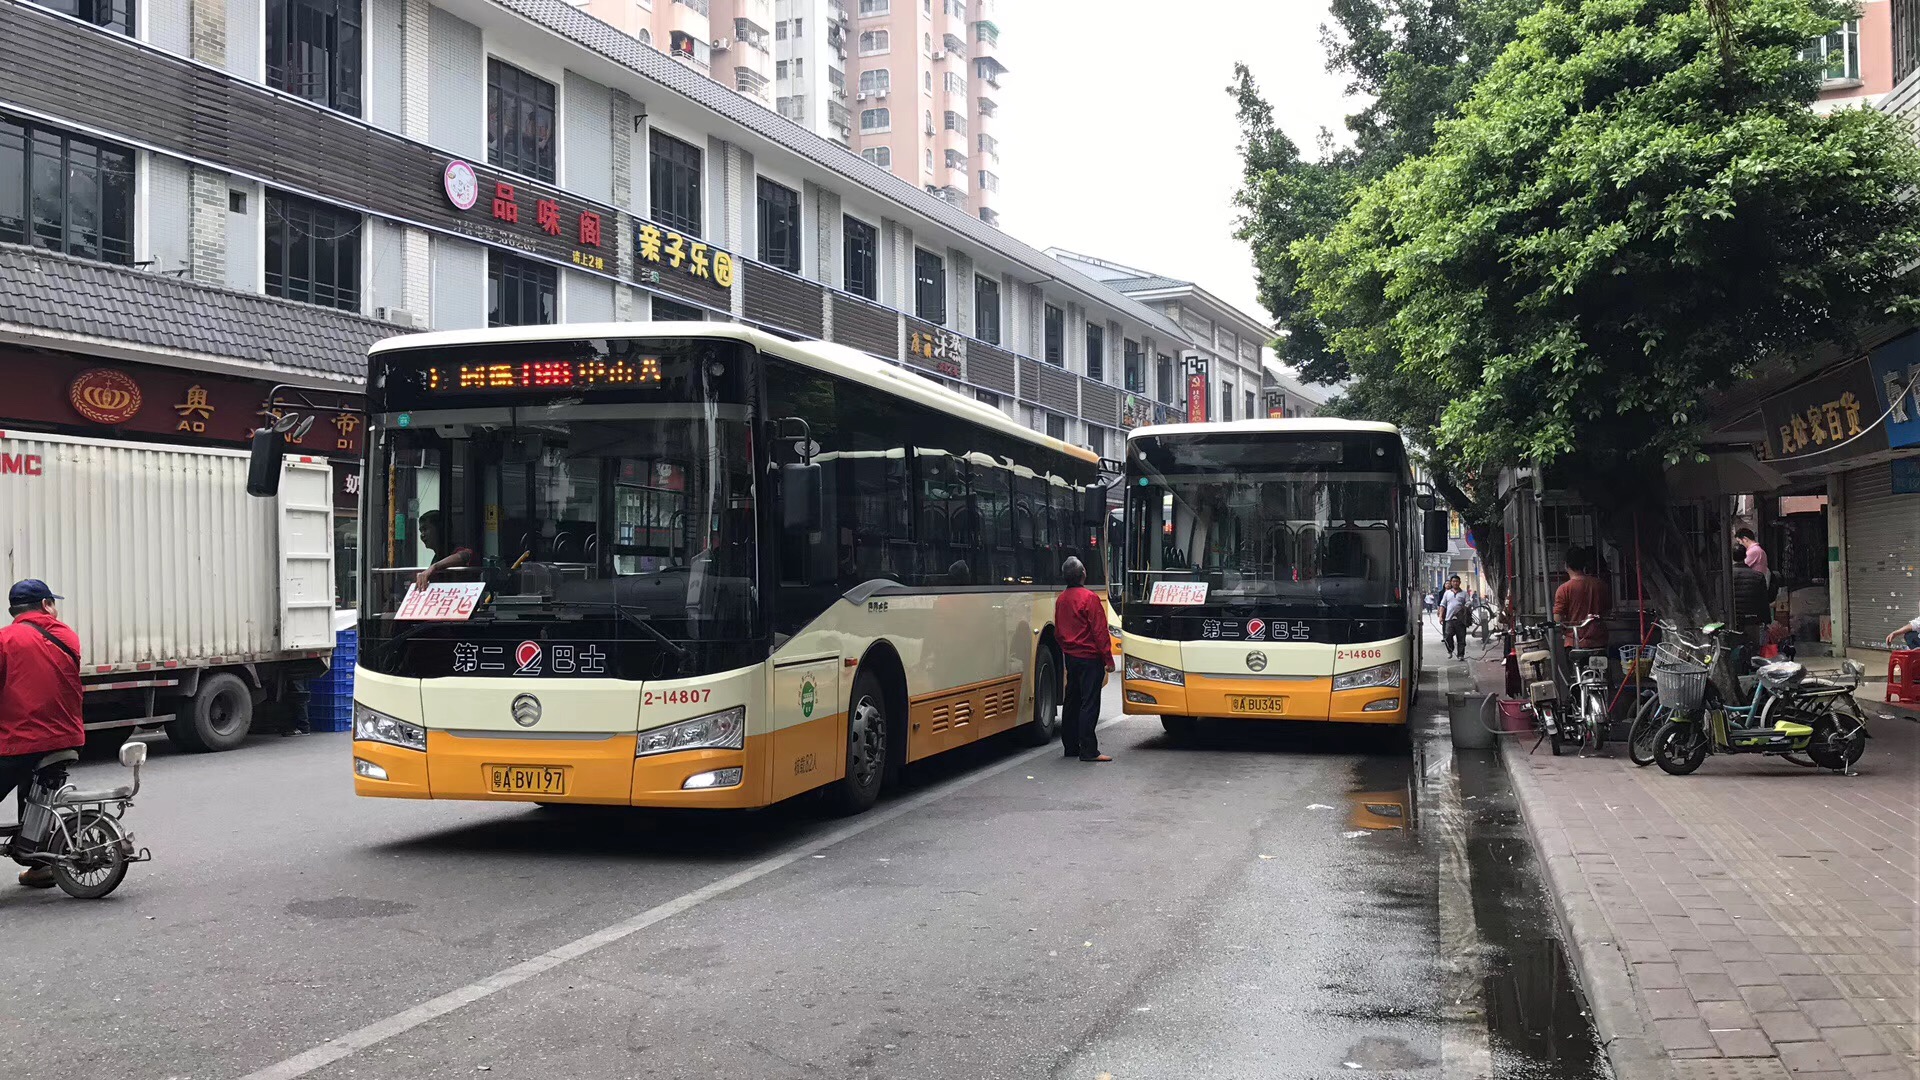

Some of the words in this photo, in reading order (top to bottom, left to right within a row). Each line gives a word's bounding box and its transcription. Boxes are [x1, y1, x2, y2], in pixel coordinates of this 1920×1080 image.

[492, 182, 601, 247] 品味阁
[637, 223, 733, 287] 亲子乐园
[178, 419, 206, 433] AO
[337, 438, 353, 449] DI
[0, 452, 42, 476] MC
[401, 585, 480, 617] 暂停营运
[1153, 583, 1206, 603] 暂停营运
[1202, 619, 1240, 639] 第二
[1271, 620, 1310, 640] 巴士
[453, 642, 505, 673] 第二
[551, 644, 606, 673] 巴士
[1337, 648, 1382, 660] 2-14806
[644, 688, 712, 706] 2-14807
